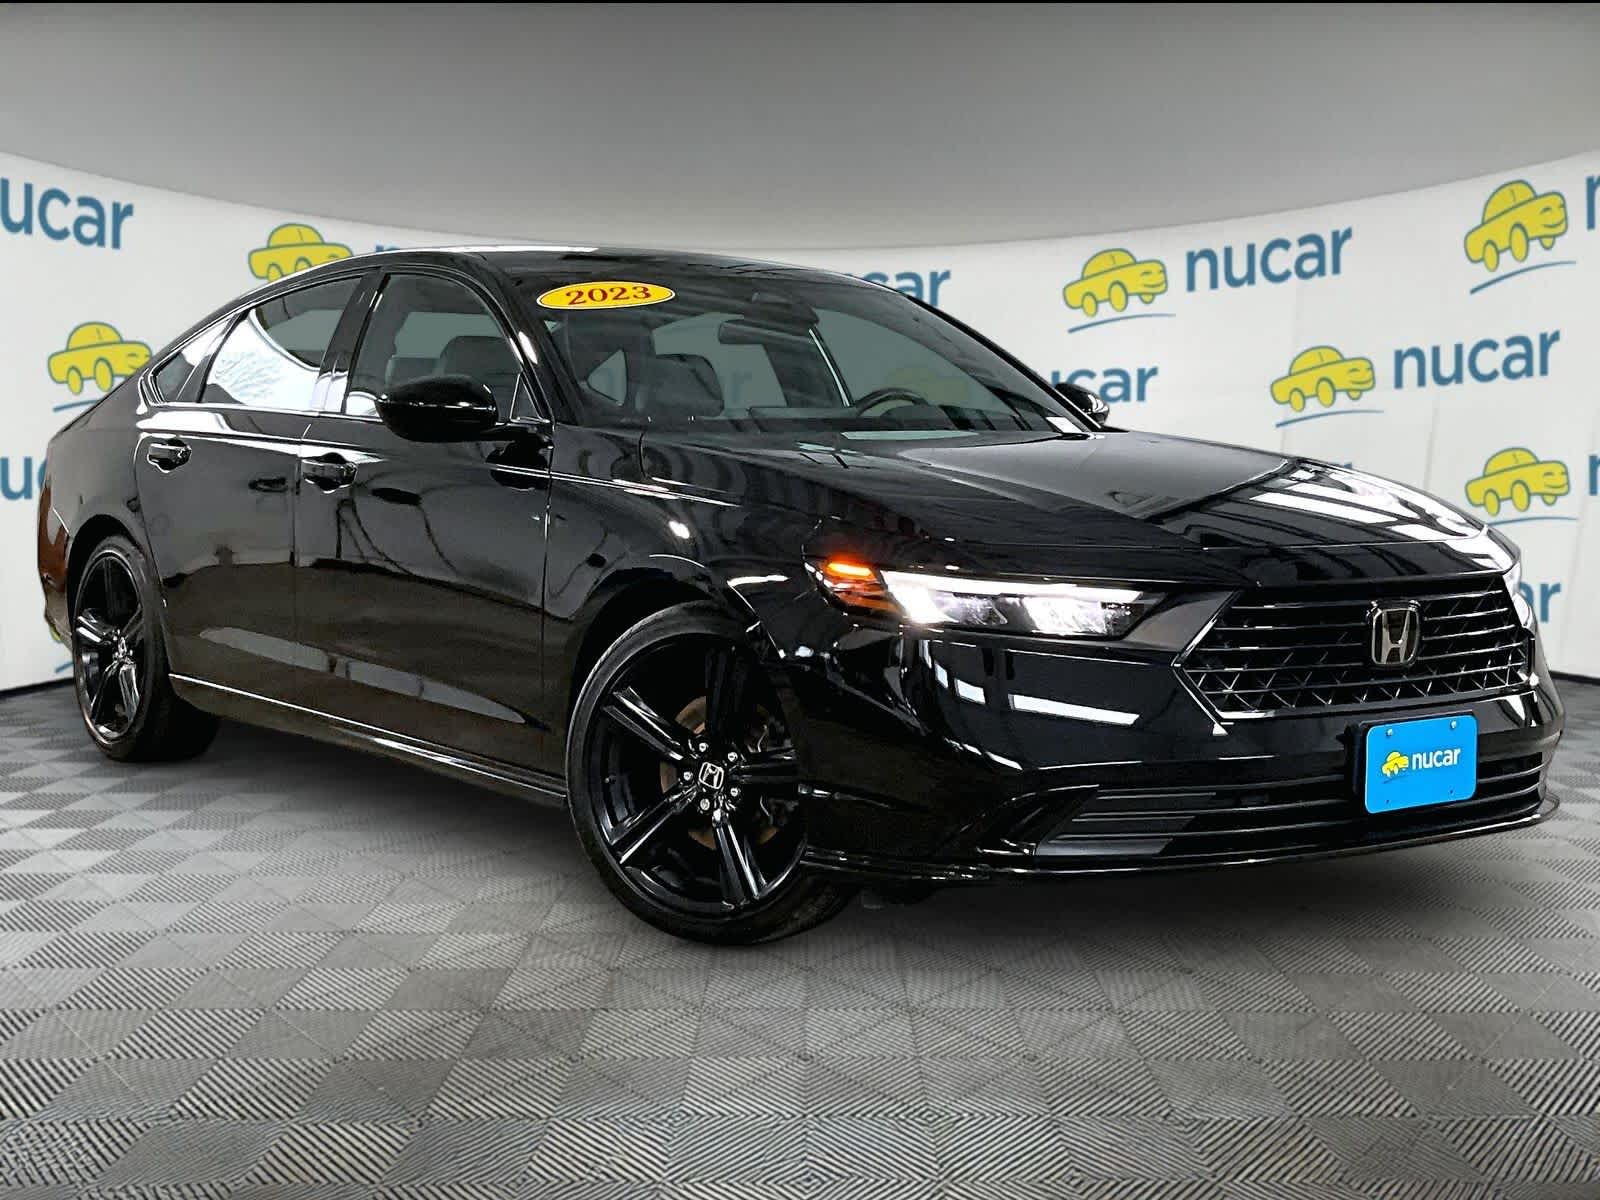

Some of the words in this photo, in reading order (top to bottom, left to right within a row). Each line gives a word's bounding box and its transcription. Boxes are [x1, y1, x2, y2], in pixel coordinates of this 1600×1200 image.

[1187, 227, 1352, 293] nucar
[565, 286, 652, 305] 2023
[1393, 330, 1561, 389] nucar
[1412, 748, 1461, 770] nucar
